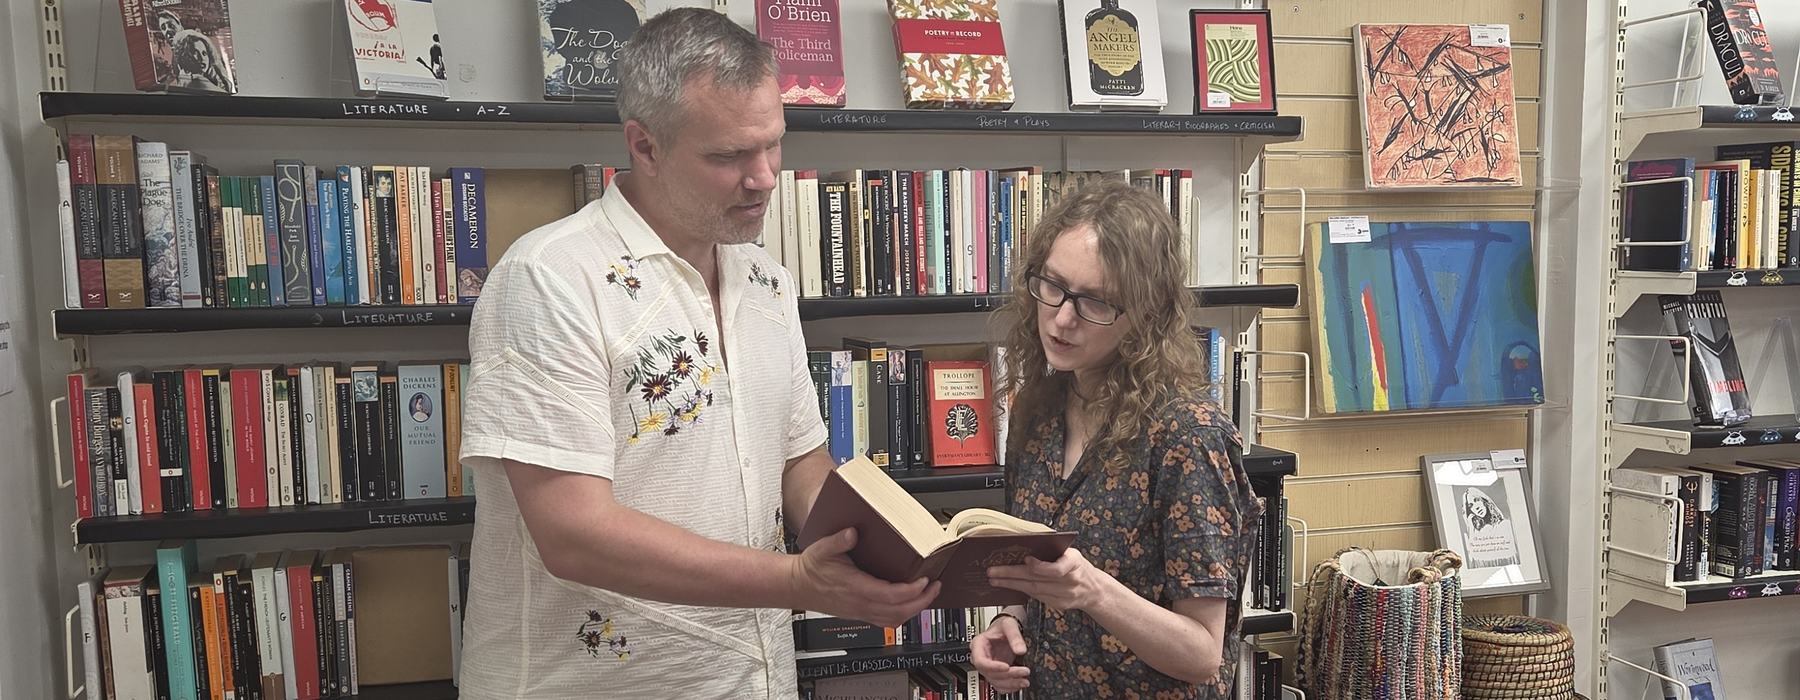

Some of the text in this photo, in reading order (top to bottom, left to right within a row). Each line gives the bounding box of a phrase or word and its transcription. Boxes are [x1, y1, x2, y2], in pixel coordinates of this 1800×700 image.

[768, 6, 831, 22] O'Brien
[550, 27, 628, 61] The Dog
[771, 37, 831, 50] The Third
[1090, 33, 1136, 43] ANGEL
[355, 48, 404, 59] VICTORIA!
[772, 49, 833, 62] Policeman
[1711, 22, 1742, 78] DRACUL
[572, 52, 612, 64] and the
[567, 63, 619, 85] Wolv
[343, 103, 510, 116] LITERATURE A-Z
[821, 114, 886, 124] LITERATURE
[976, 115, 1050, 128] POETRY PLAYS
[1143, 120, 1180, 129] LITERARY
[144, 179, 160, 187] The
[140, 189, 168, 199] Plague
[143, 198, 166, 207] Dogs
[342, 188, 350, 214] PLAYING
[467, 184, 478, 248] DECAMERON
[445, 220, 454, 246] SAMMLER'S
[829, 192, 844, 284] THE FOUNTAINHEAD
[447, 247, 455, 263] PLANET
[1688, 303, 1726, 318] CRICHTON
[342, 310, 433, 325] LITERATURE
[90, 391, 107, 455] Anthony Burgess
[125, 416, 132, 424] C
[305, 413, 313, 423] D
[369, 510, 447, 524] LITERATURE
[168, 572, 176, 596] SCOTT
[170, 599, 180, 645] FITZGERALD
[85, 632, 90, 643] F
[897, 657, 923, 668] MYTH
